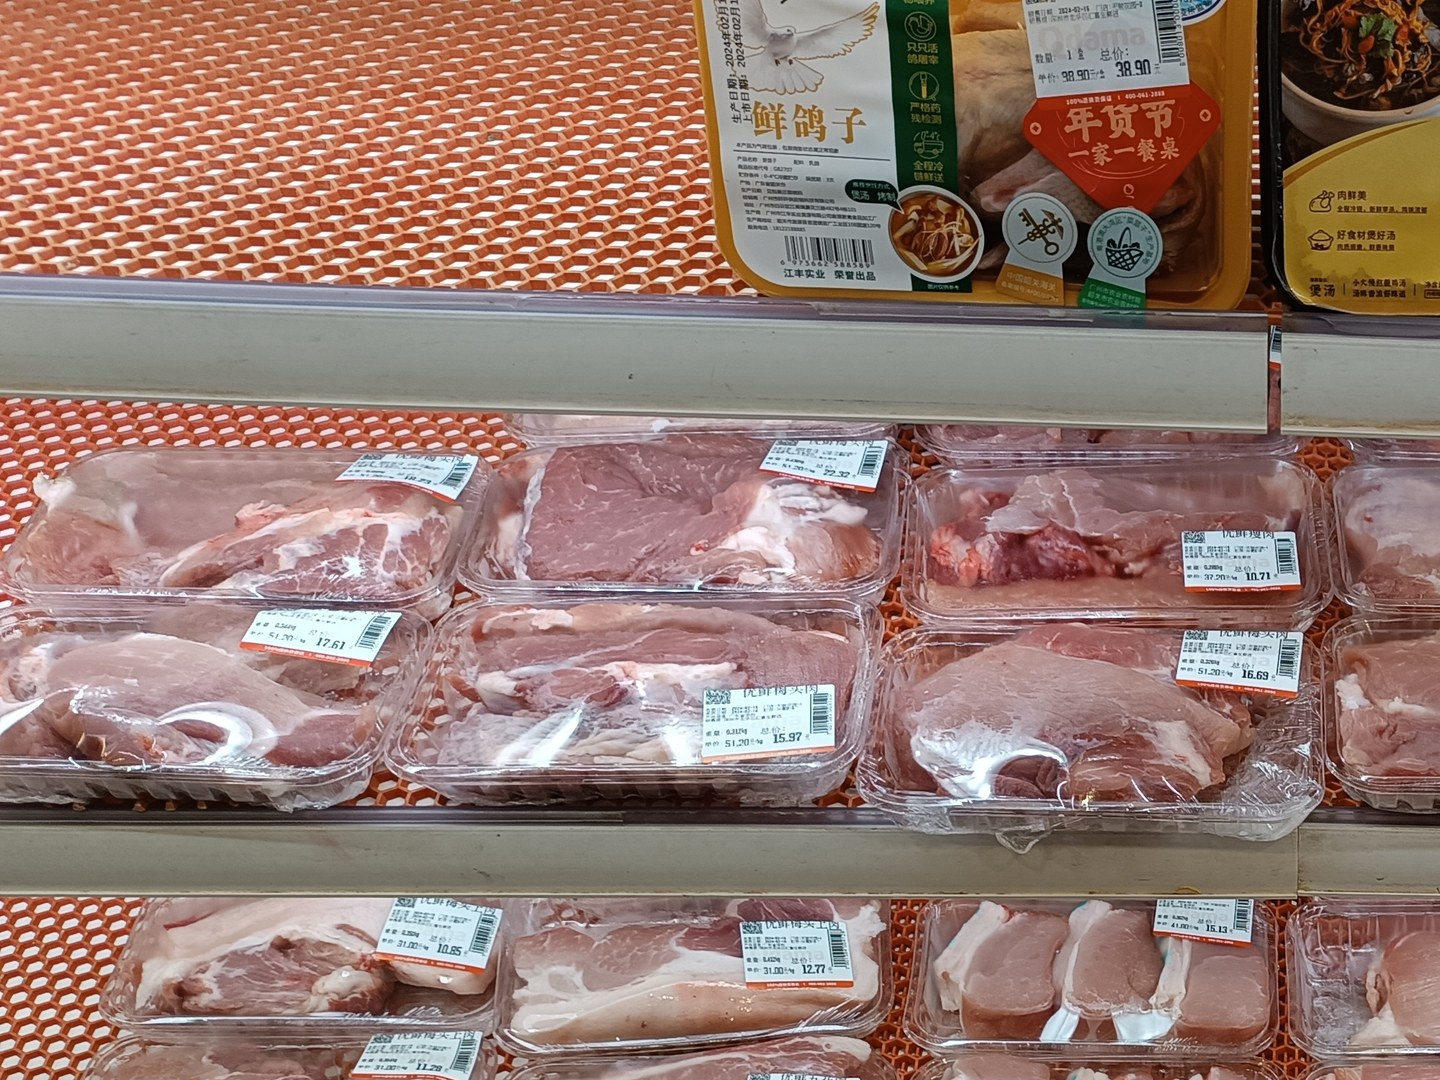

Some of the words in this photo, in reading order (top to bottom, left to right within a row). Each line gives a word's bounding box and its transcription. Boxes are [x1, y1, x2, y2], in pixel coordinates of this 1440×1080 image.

[907, 42, 938, 54] 只只活
[1100, 48, 1130, 61] 总价：
[1115, 59, 1151, 78] 38.90
[910, 102, 941, 113] 严格药
[752, 100, 867, 143] 鲜鸽子
[911, 113, 942, 124] 残检测
[1064, 99, 1176, 143] 年货节
[1068, 136, 1180, 167] 一家一餐桌
[913, 161, 944, 171] 全程冷
[851, 191, 870, 201] 煲汤
[877, 191, 897, 202] 烤制
[1337, 190, 1367, 201] 肉鲜美
[1337, 230, 1396, 241] 好食材煲好汤
[784, 268, 826, 279] 江丰实业
[834, 270, 877, 281] 荣誉出品
[1309, 284, 1336, 298] 煲汤
[1246, 572, 1271, 581] 10.71
[316, 637, 346, 649] 17.61
[1242, 670, 1269, 680] 16.69
[773, 732, 802, 743] 15.97
[1206, 925, 1228, 934] 15.13
[438, 944, 463, 955] 10.85
[802, 964, 826, 974] 12.77
